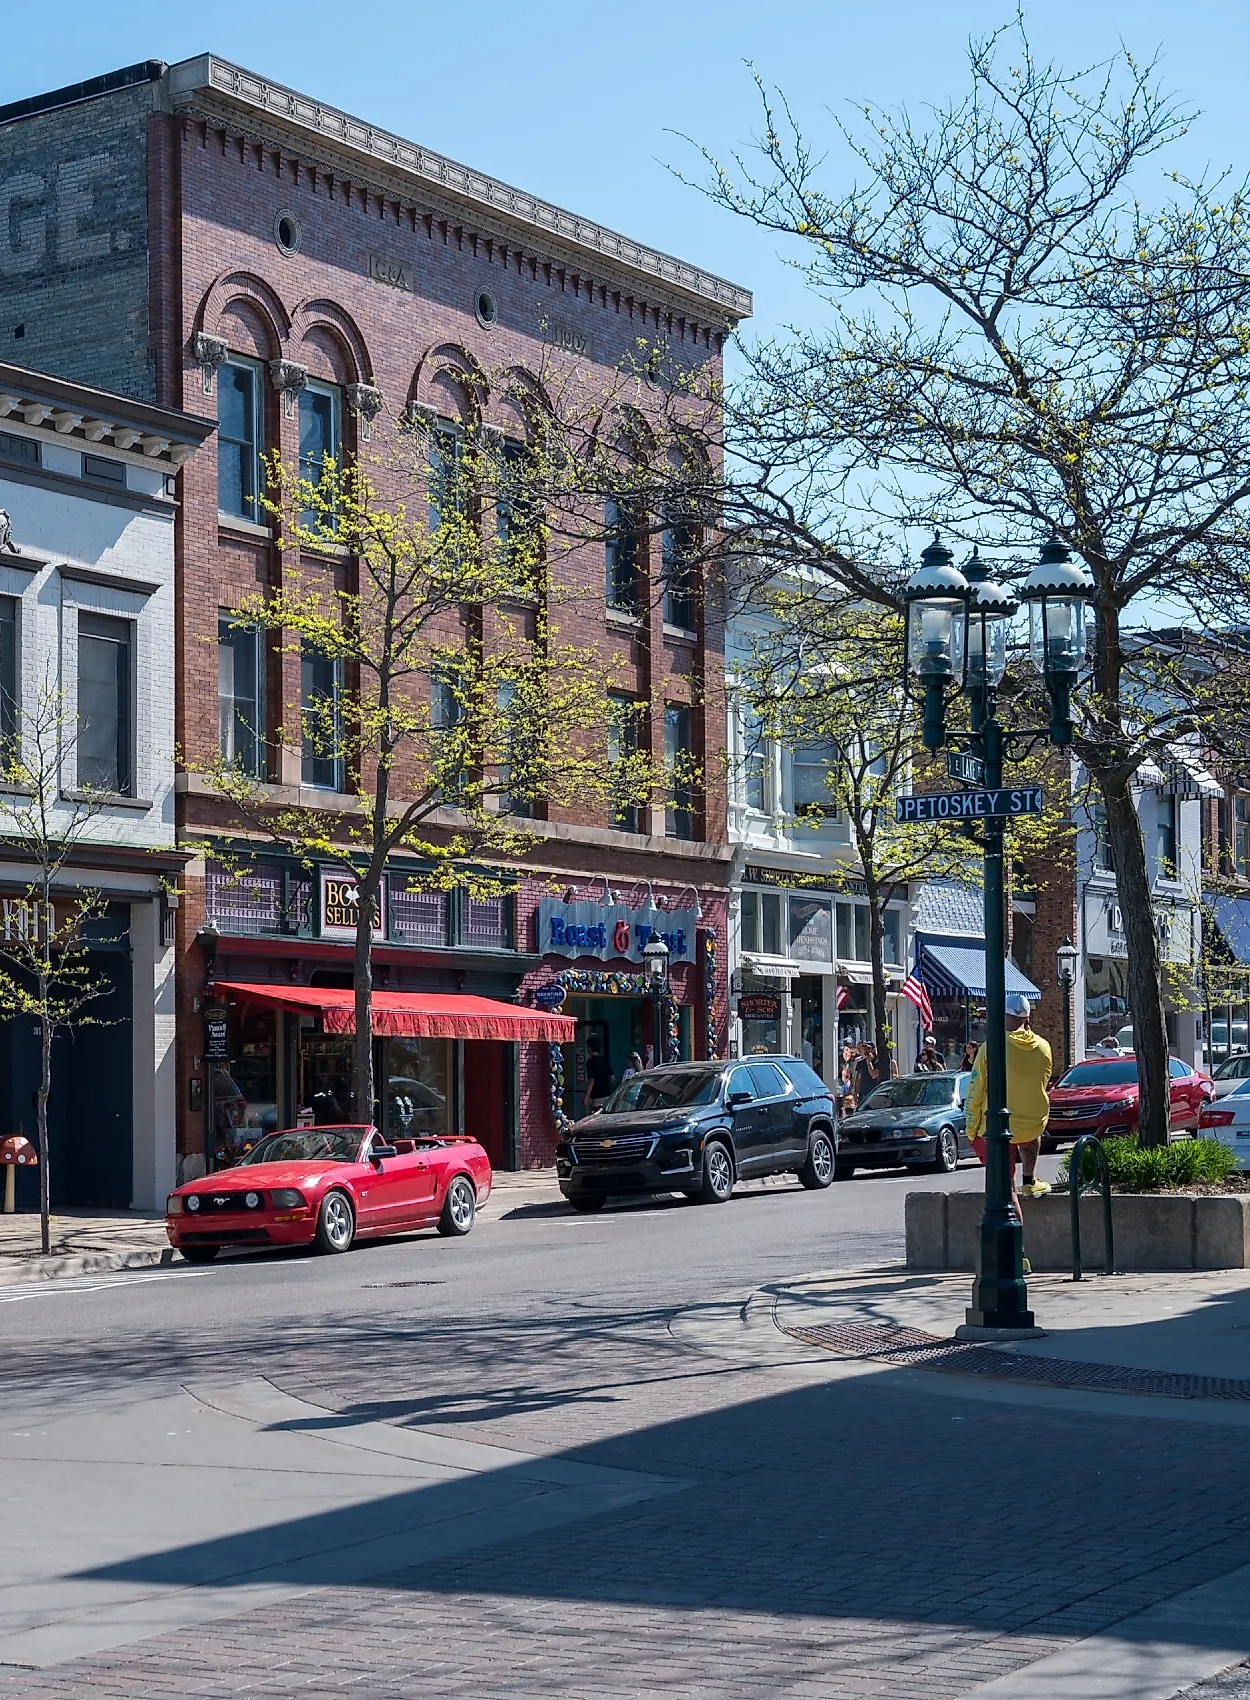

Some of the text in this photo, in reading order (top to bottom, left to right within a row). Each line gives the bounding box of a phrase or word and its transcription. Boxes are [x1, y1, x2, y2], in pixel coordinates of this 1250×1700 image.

[962, 757, 977, 781] LAKE
[905, 790, 1034, 820] PETOSKEY ST
[326, 906, 380, 928] SELLS
[550, 915, 687, 955] Roast & Tast
[741, 998, 778, 1010] SHORTER
[758, 1005, 774, 1014] SON
